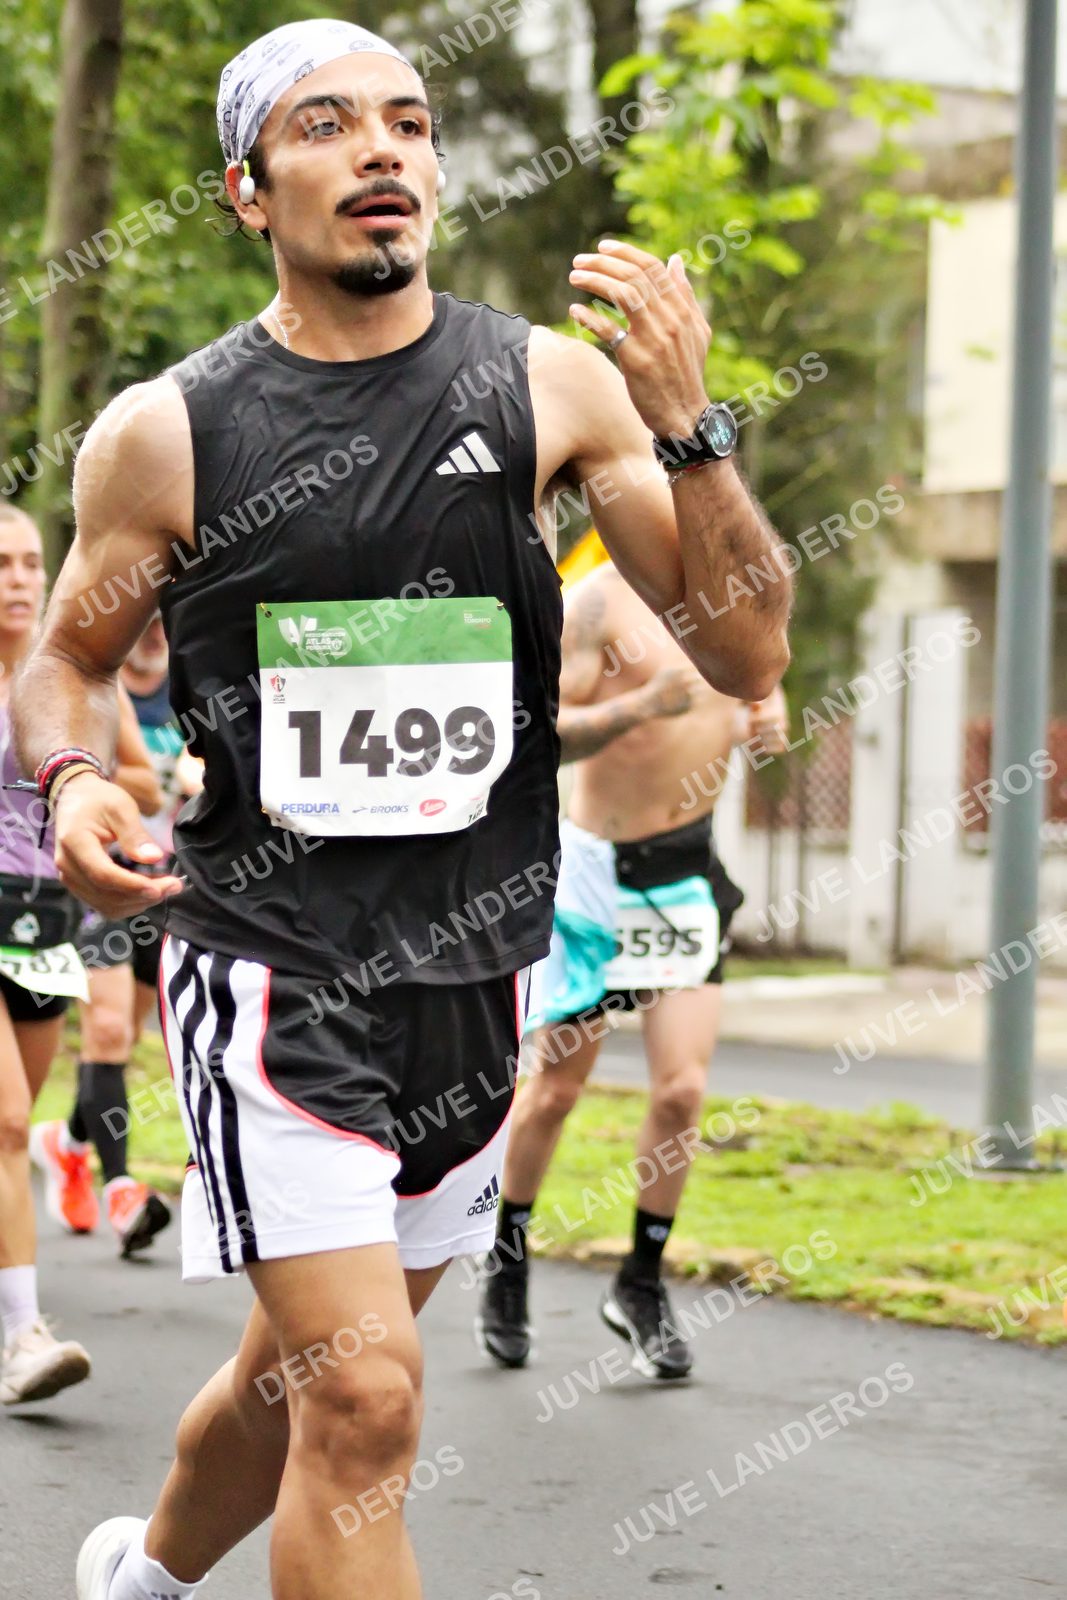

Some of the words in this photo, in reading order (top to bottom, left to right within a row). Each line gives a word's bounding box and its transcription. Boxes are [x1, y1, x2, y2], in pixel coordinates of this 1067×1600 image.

[288, 706, 496, 778] 1499
[281, 803, 340, 814] PERDURA
[370, 804, 409, 814] BROOKS
[467, 1197, 499, 1216] adida
